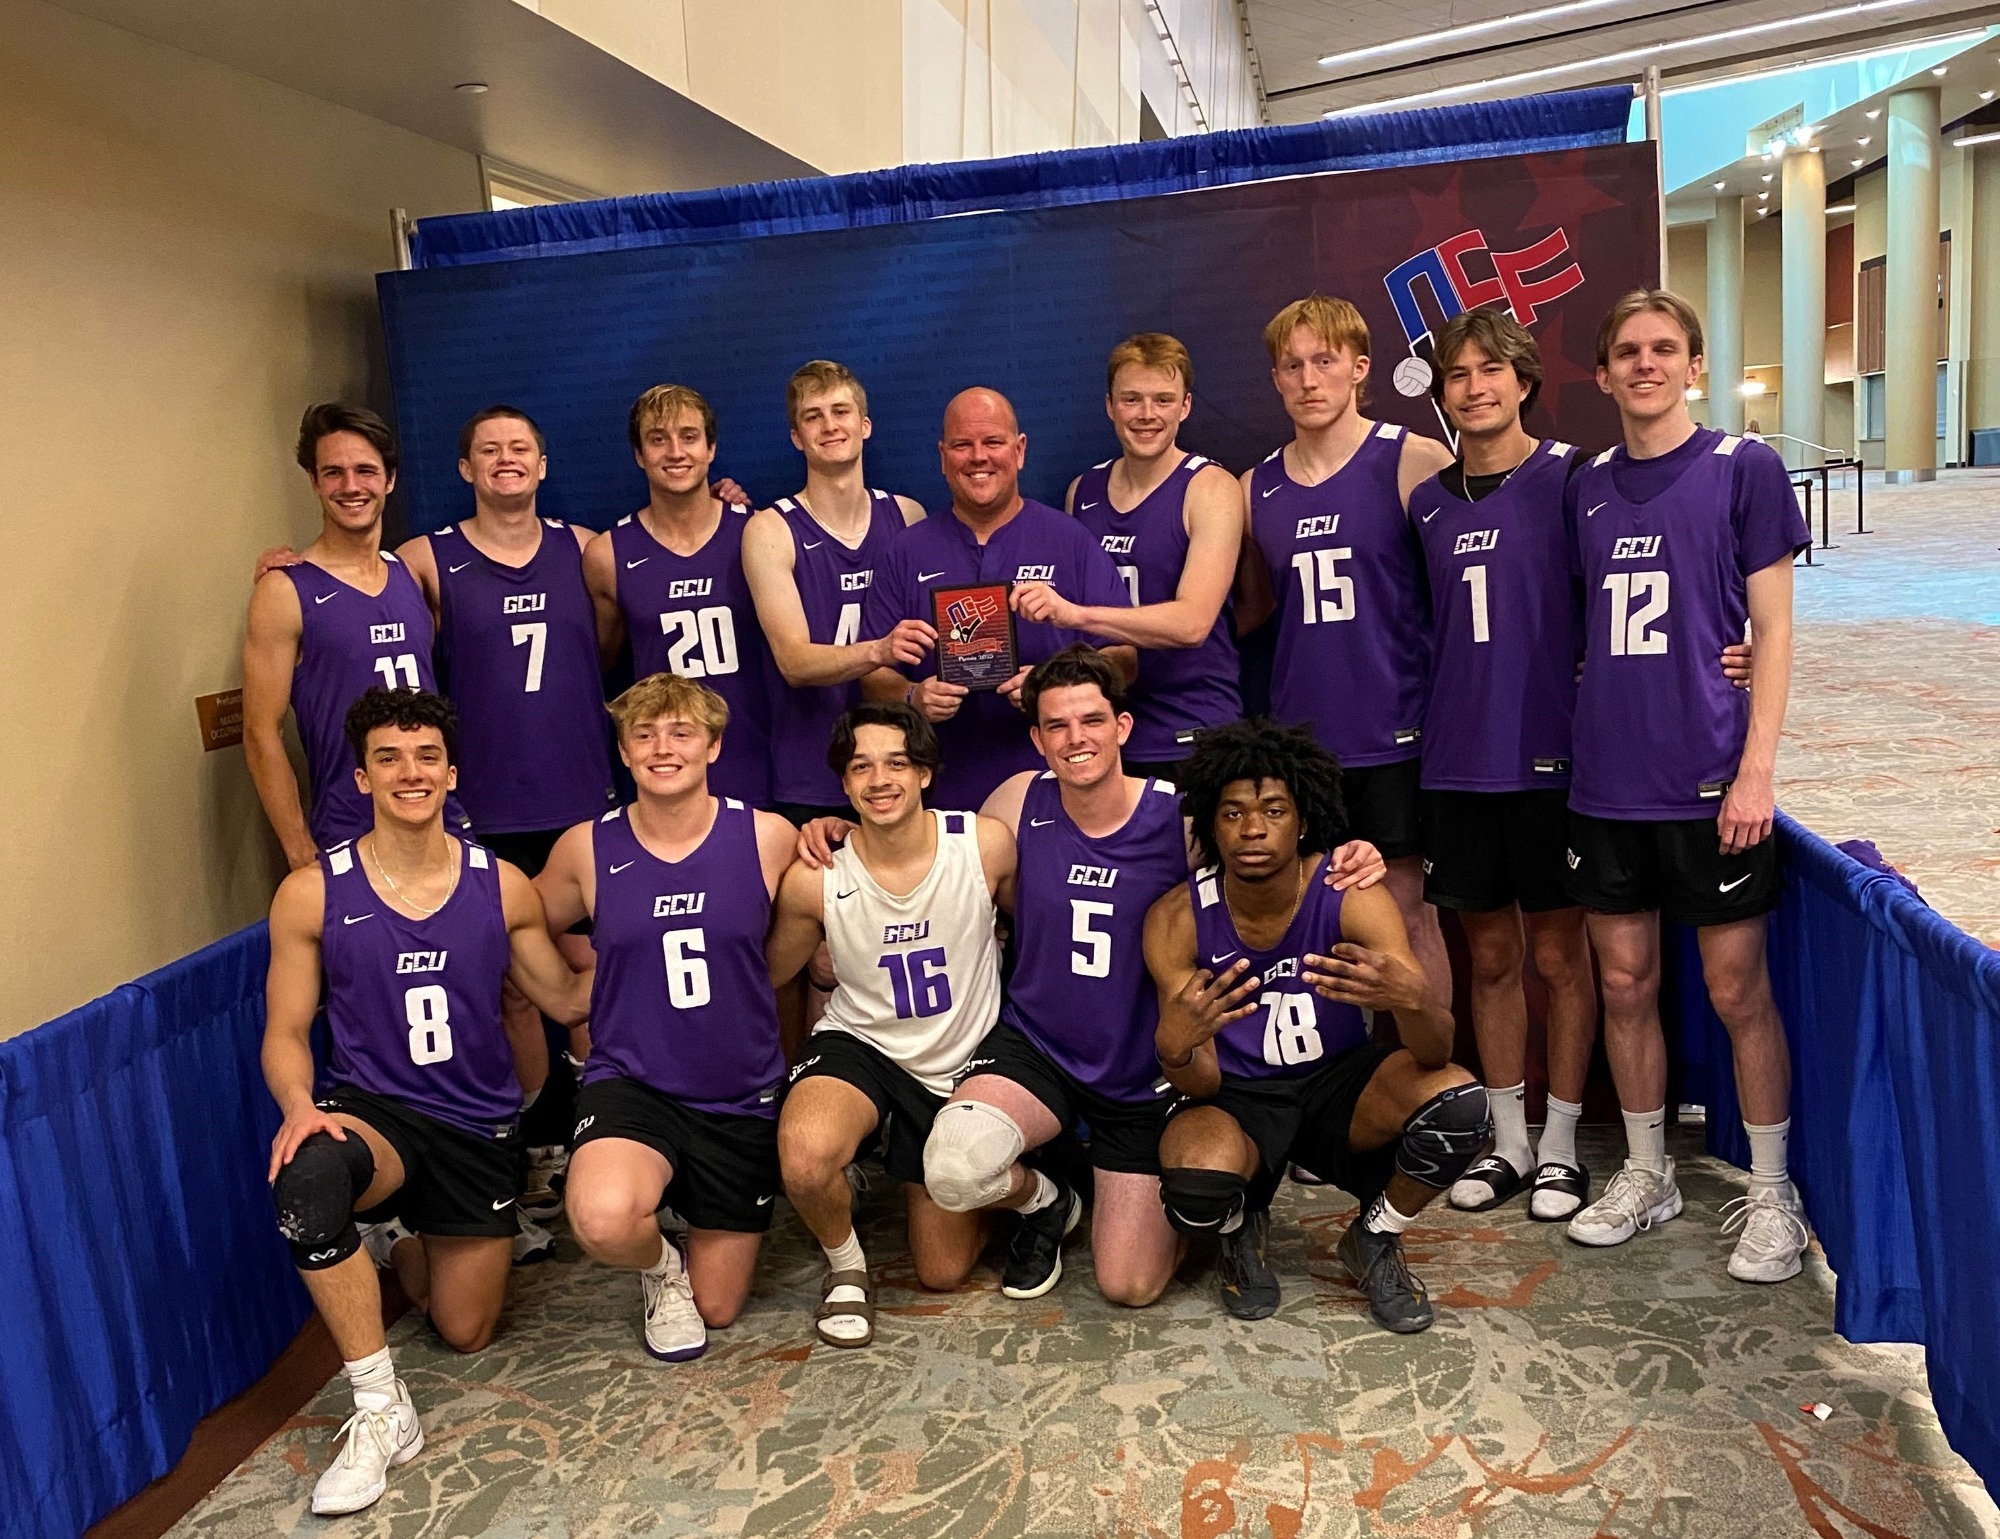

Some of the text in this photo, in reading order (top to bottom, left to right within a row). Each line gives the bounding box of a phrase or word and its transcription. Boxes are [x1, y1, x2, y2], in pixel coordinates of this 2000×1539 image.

[1296, 514, 1340, 538] GCU
[1102, 535, 1136, 553] GCU
[1453, 529, 1499, 554] GCU
[1611, 535, 1662, 559] GCU
[1016, 565, 1055, 580] GCU
[1292, 547, 1355, 623] 15
[668, 578, 713, 598] GCU
[503, 593, 546, 614] GCU
[1462, 565, 1489, 642] 1
[1602, 570, 1669, 655] 12
[369, 623, 405, 644] GCU
[660, 606, 739, 677] 20
[511, 622, 547, 692] 7
[1067, 864, 1117, 888] GCU
[653, 892, 705, 918] GCU
[883, 920, 930, 944] GCU
[1070, 899, 1113, 978] 5
[396, 951, 448, 974] GCU
[662, 928, 710, 1009] 6
[878, 947, 953, 1019] 16
[405, 984, 453, 1066] 8
[1260, 991, 1324, 1066] 18
[1540, 1166, 1569, 1178] NIKE
